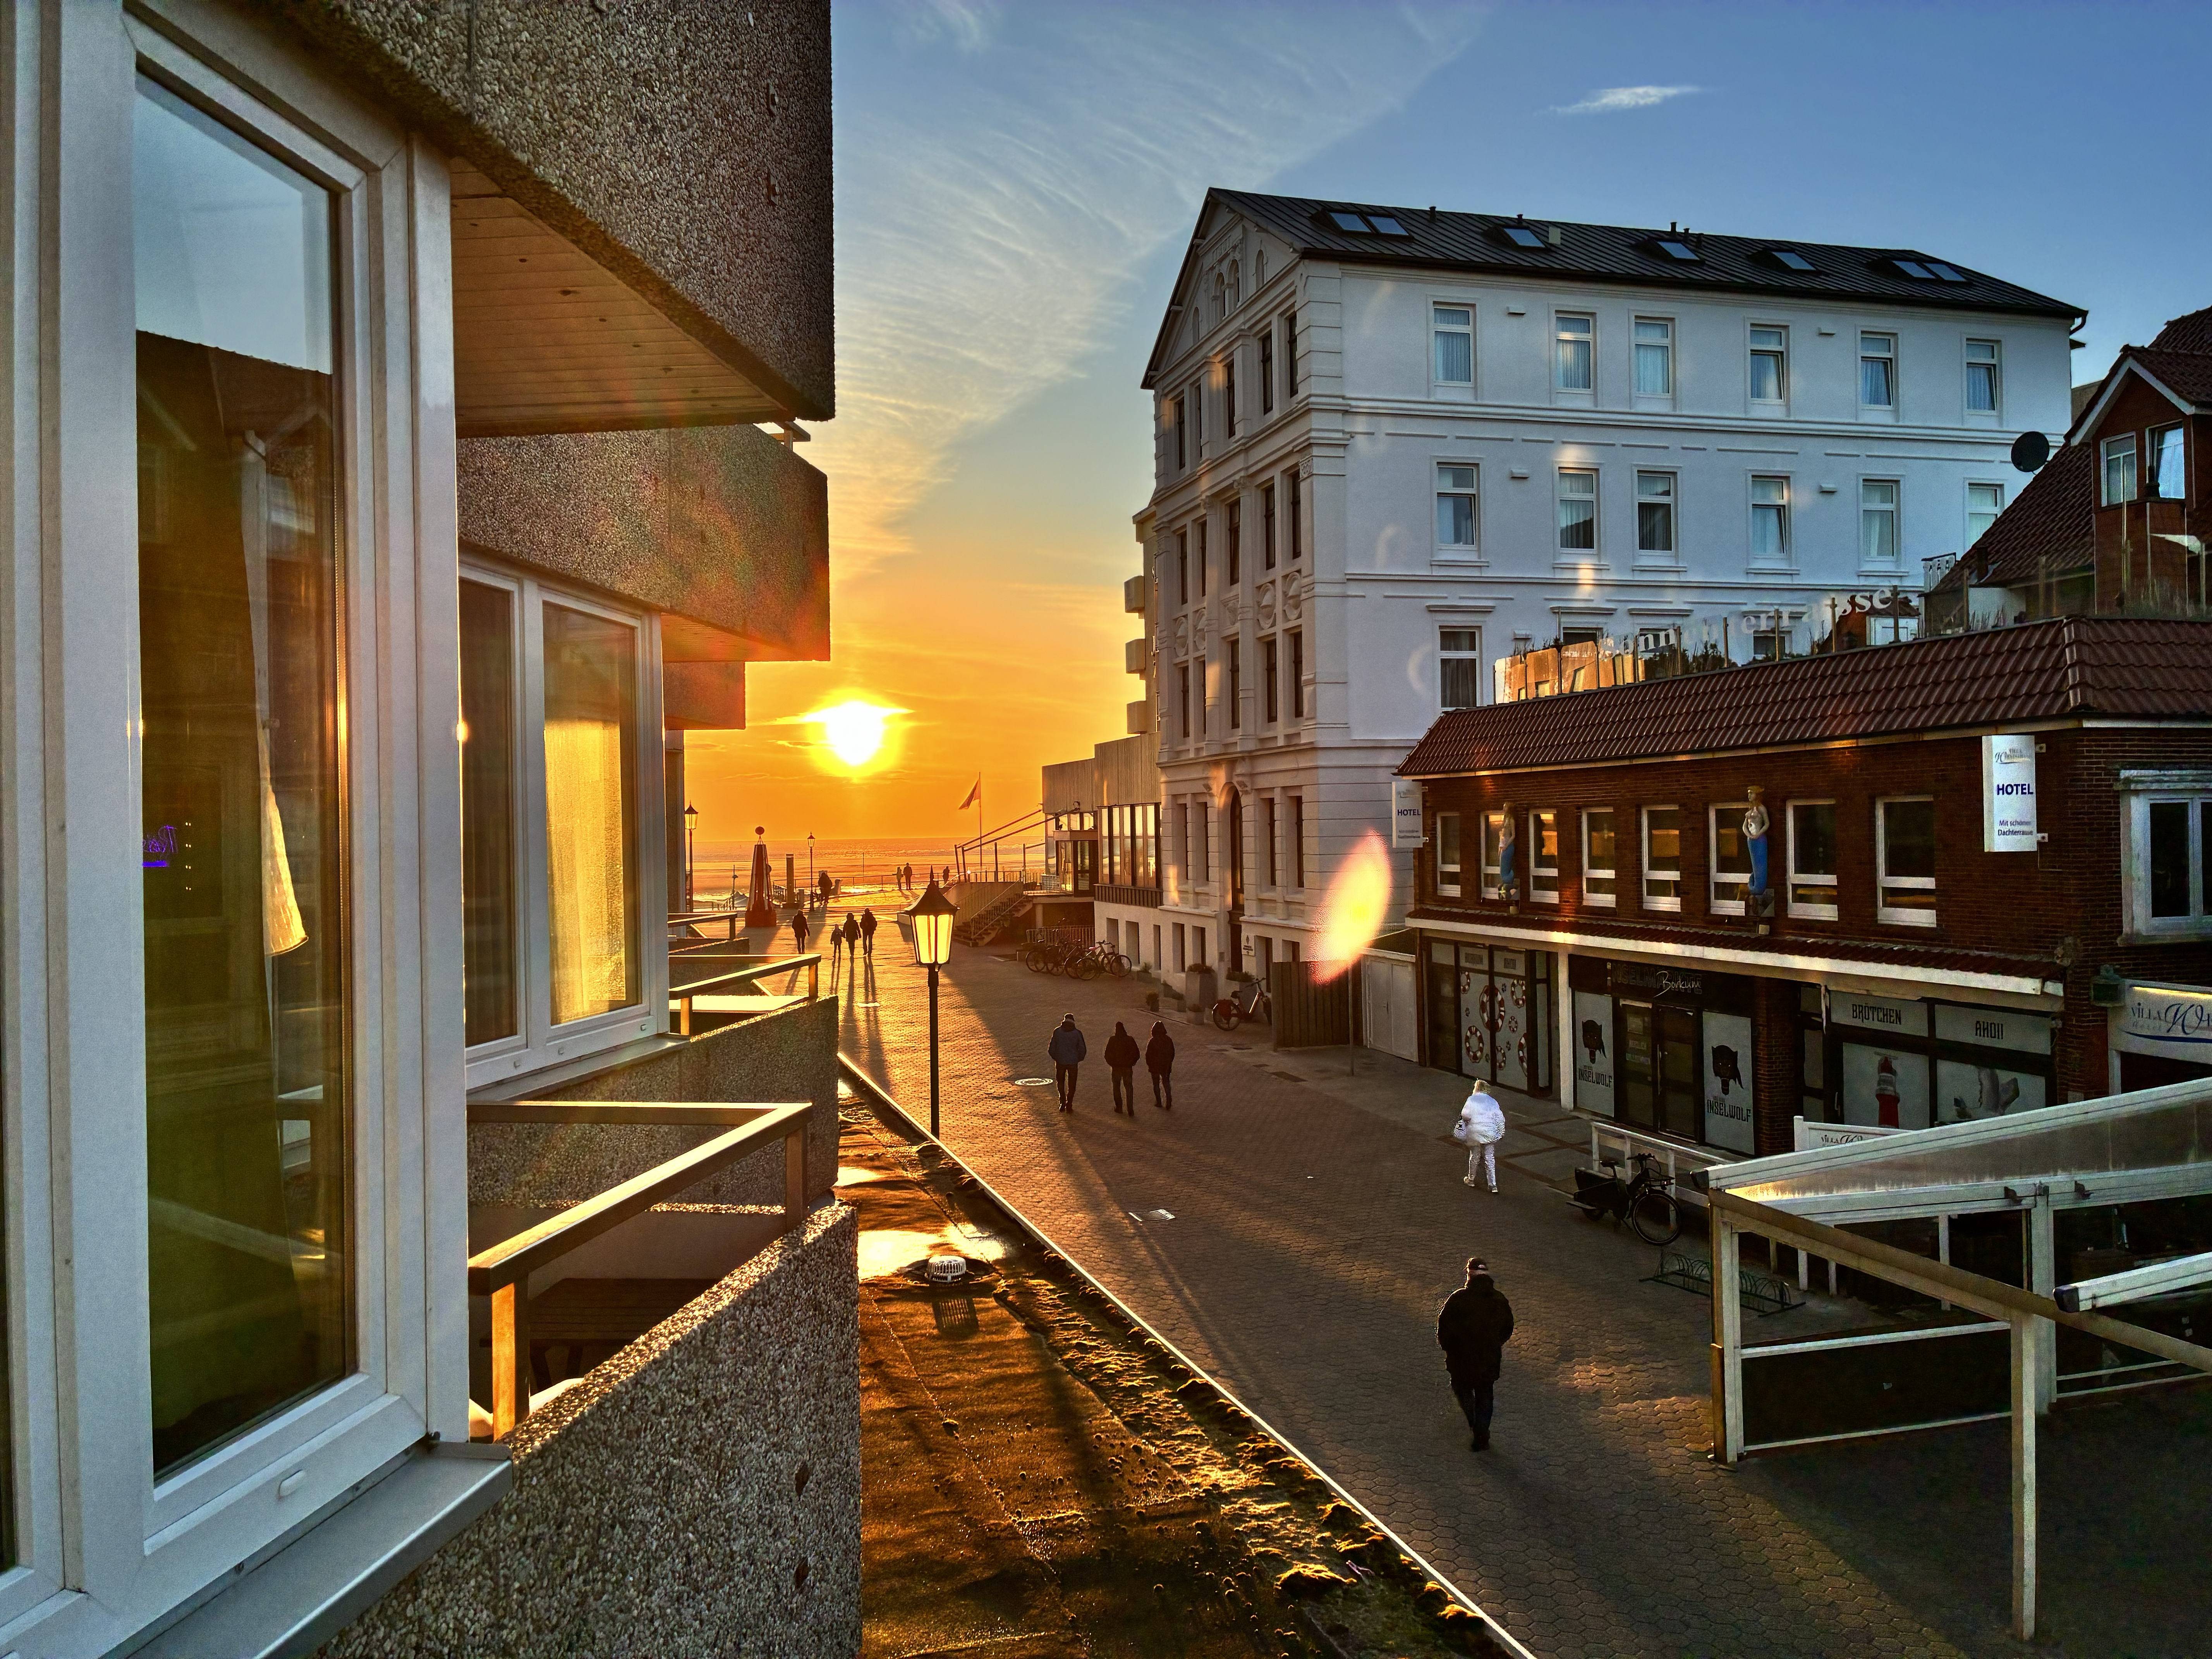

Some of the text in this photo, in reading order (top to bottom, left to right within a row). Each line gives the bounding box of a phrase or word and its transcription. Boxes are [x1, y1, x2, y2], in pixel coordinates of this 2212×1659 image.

[1997, 783, 2033, 795] HOTEL
[1852, 1003, 1902, 1025] BRÖTCHEN
[1578, 1068, 1613, 1088] INSELWOLF
[1707, 1099, 1752, 1123] INSELWOLF
